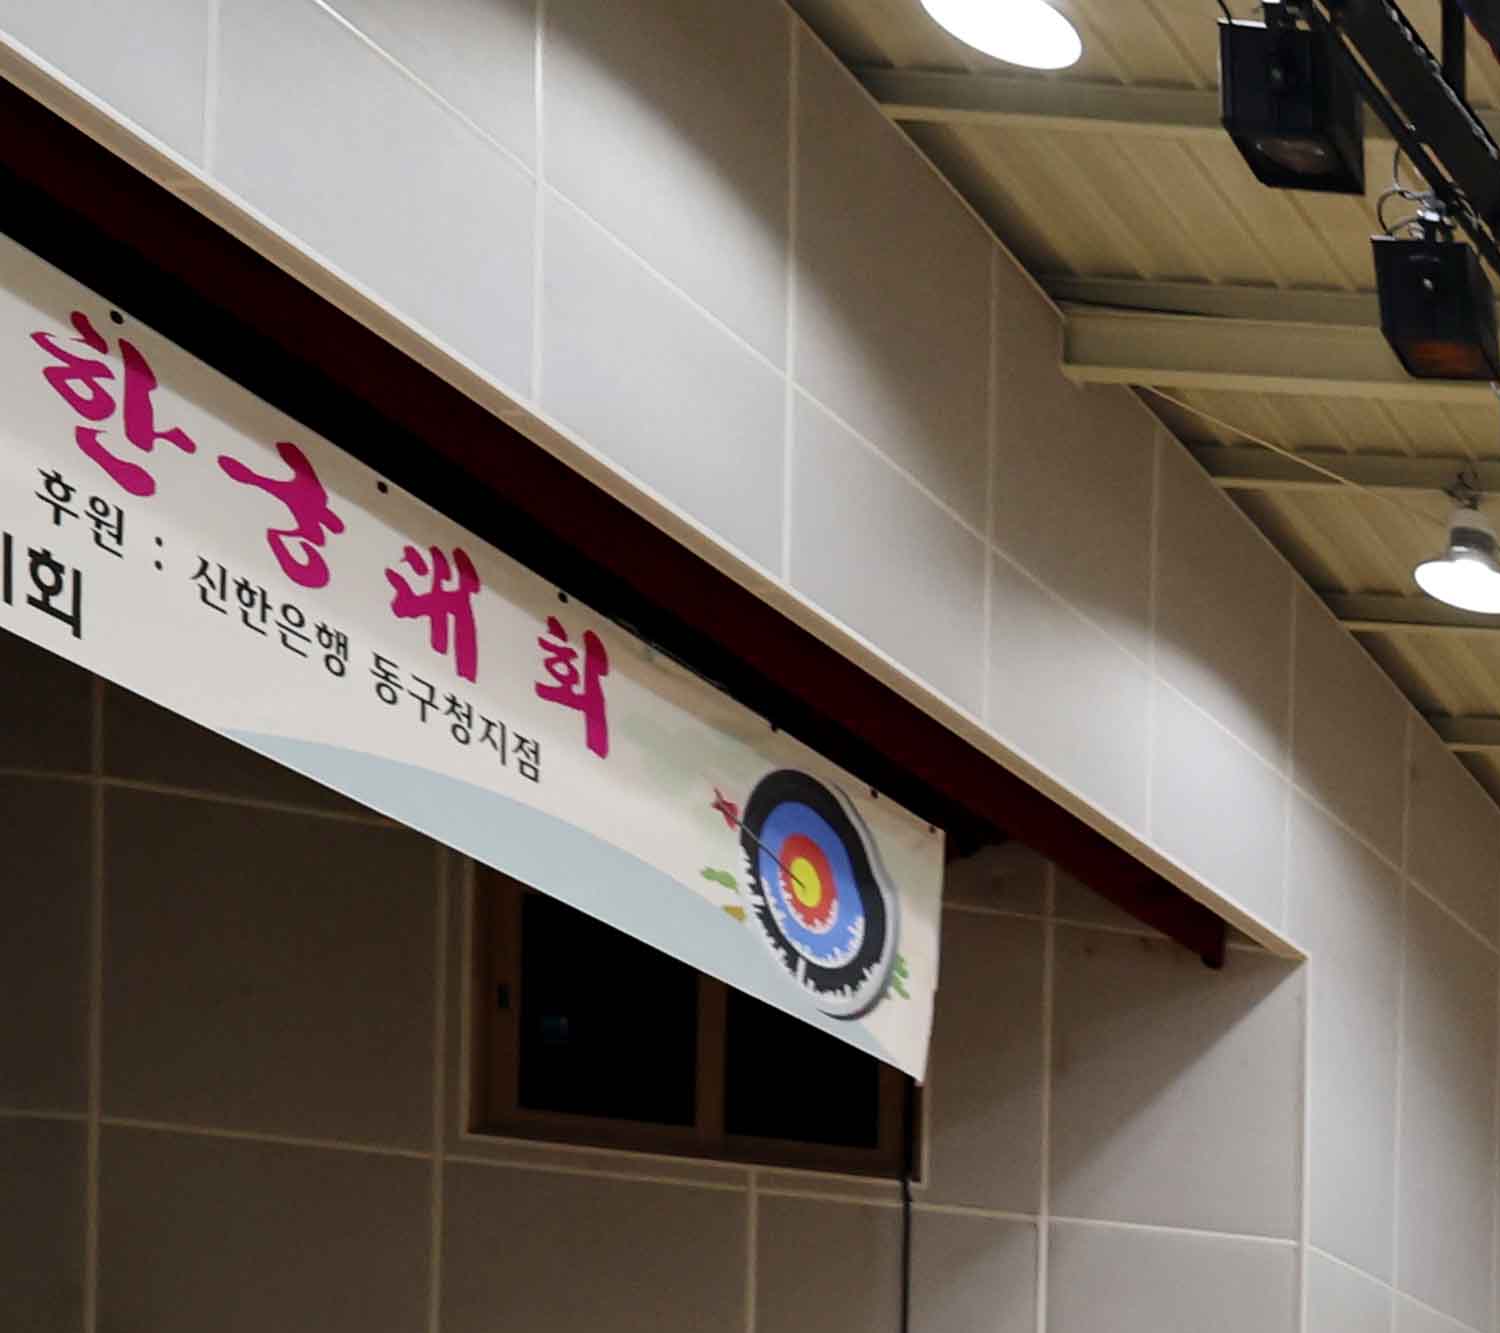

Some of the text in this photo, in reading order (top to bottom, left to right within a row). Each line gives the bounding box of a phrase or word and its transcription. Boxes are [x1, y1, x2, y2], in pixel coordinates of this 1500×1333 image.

[31, 311, 610, 759] 한궁대회
[35, 466, 125, 560] 후원
[191, 555, 349, 678] 신한은행
[370, 652, 542, 784] 동구청지점
